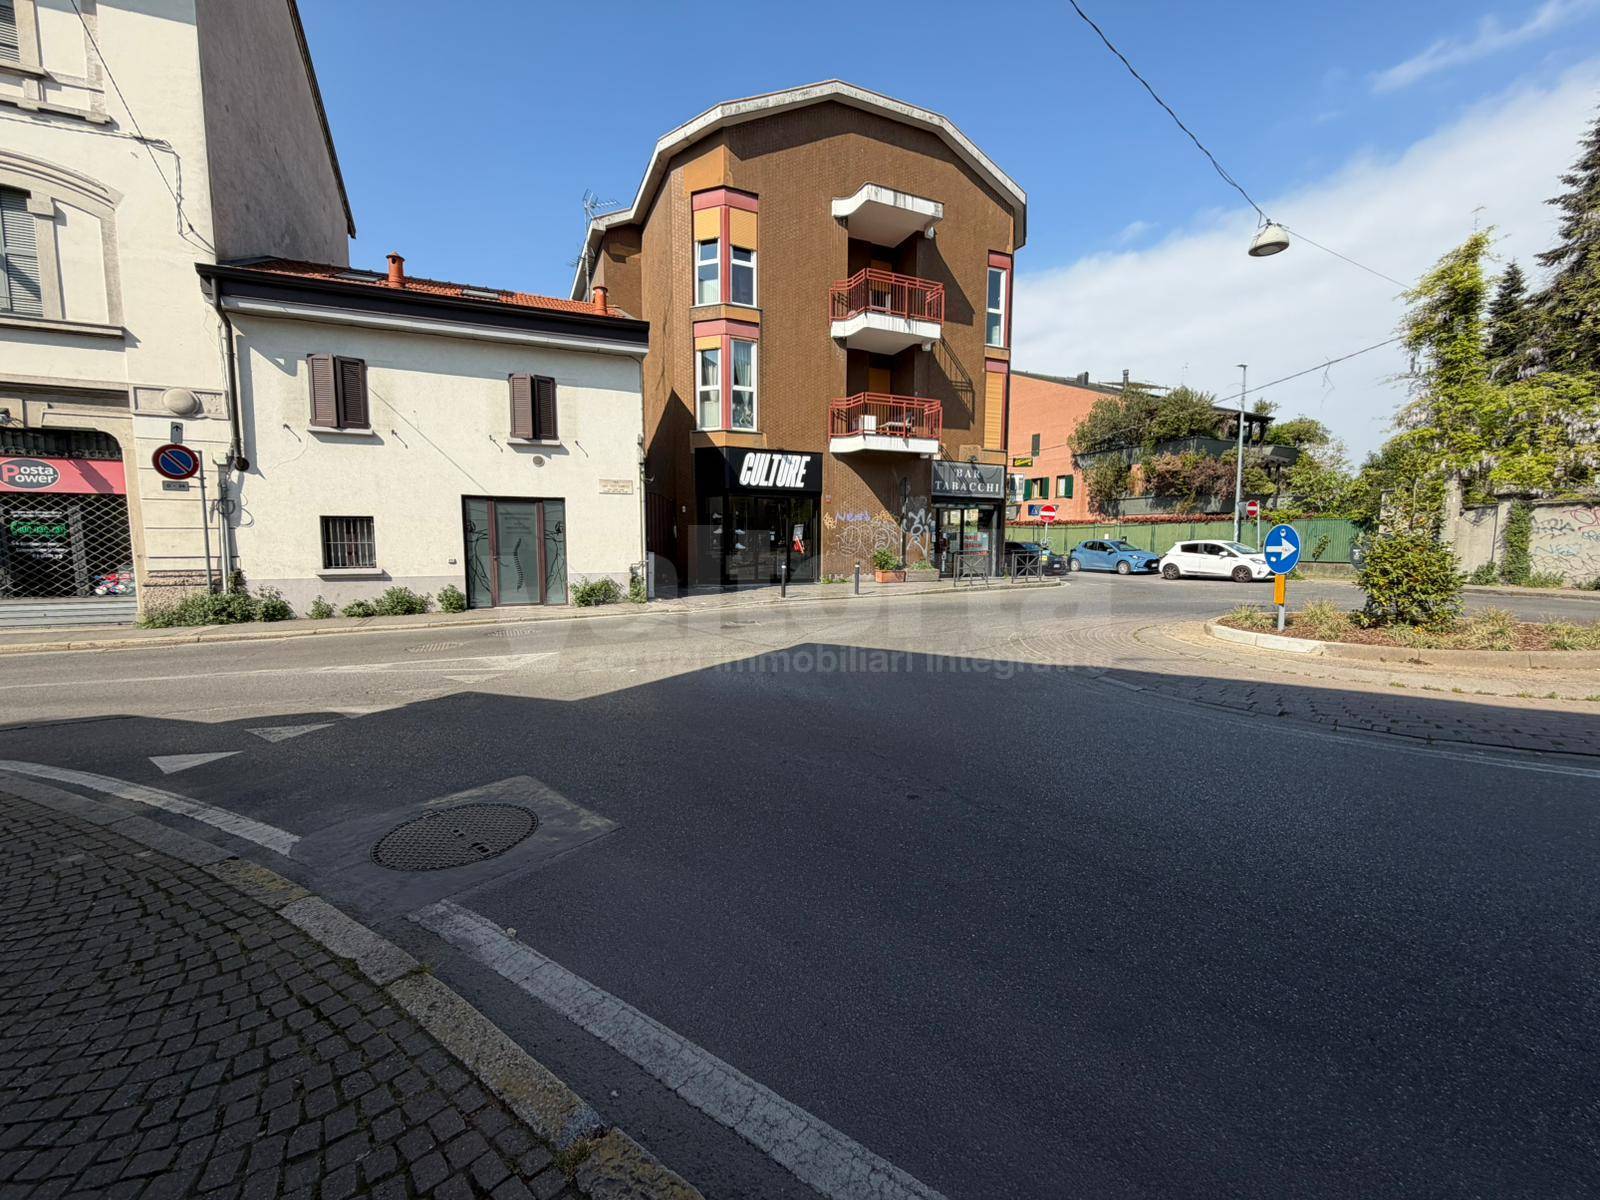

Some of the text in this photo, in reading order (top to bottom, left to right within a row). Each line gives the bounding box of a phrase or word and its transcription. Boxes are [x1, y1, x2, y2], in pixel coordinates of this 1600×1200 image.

[2, 464, 54, 479] Posta
[739, 452, 811, 488] CULTURE
[954, 468, 981, 478] BAR
[935, 480, 999, 492] TABACCHI
